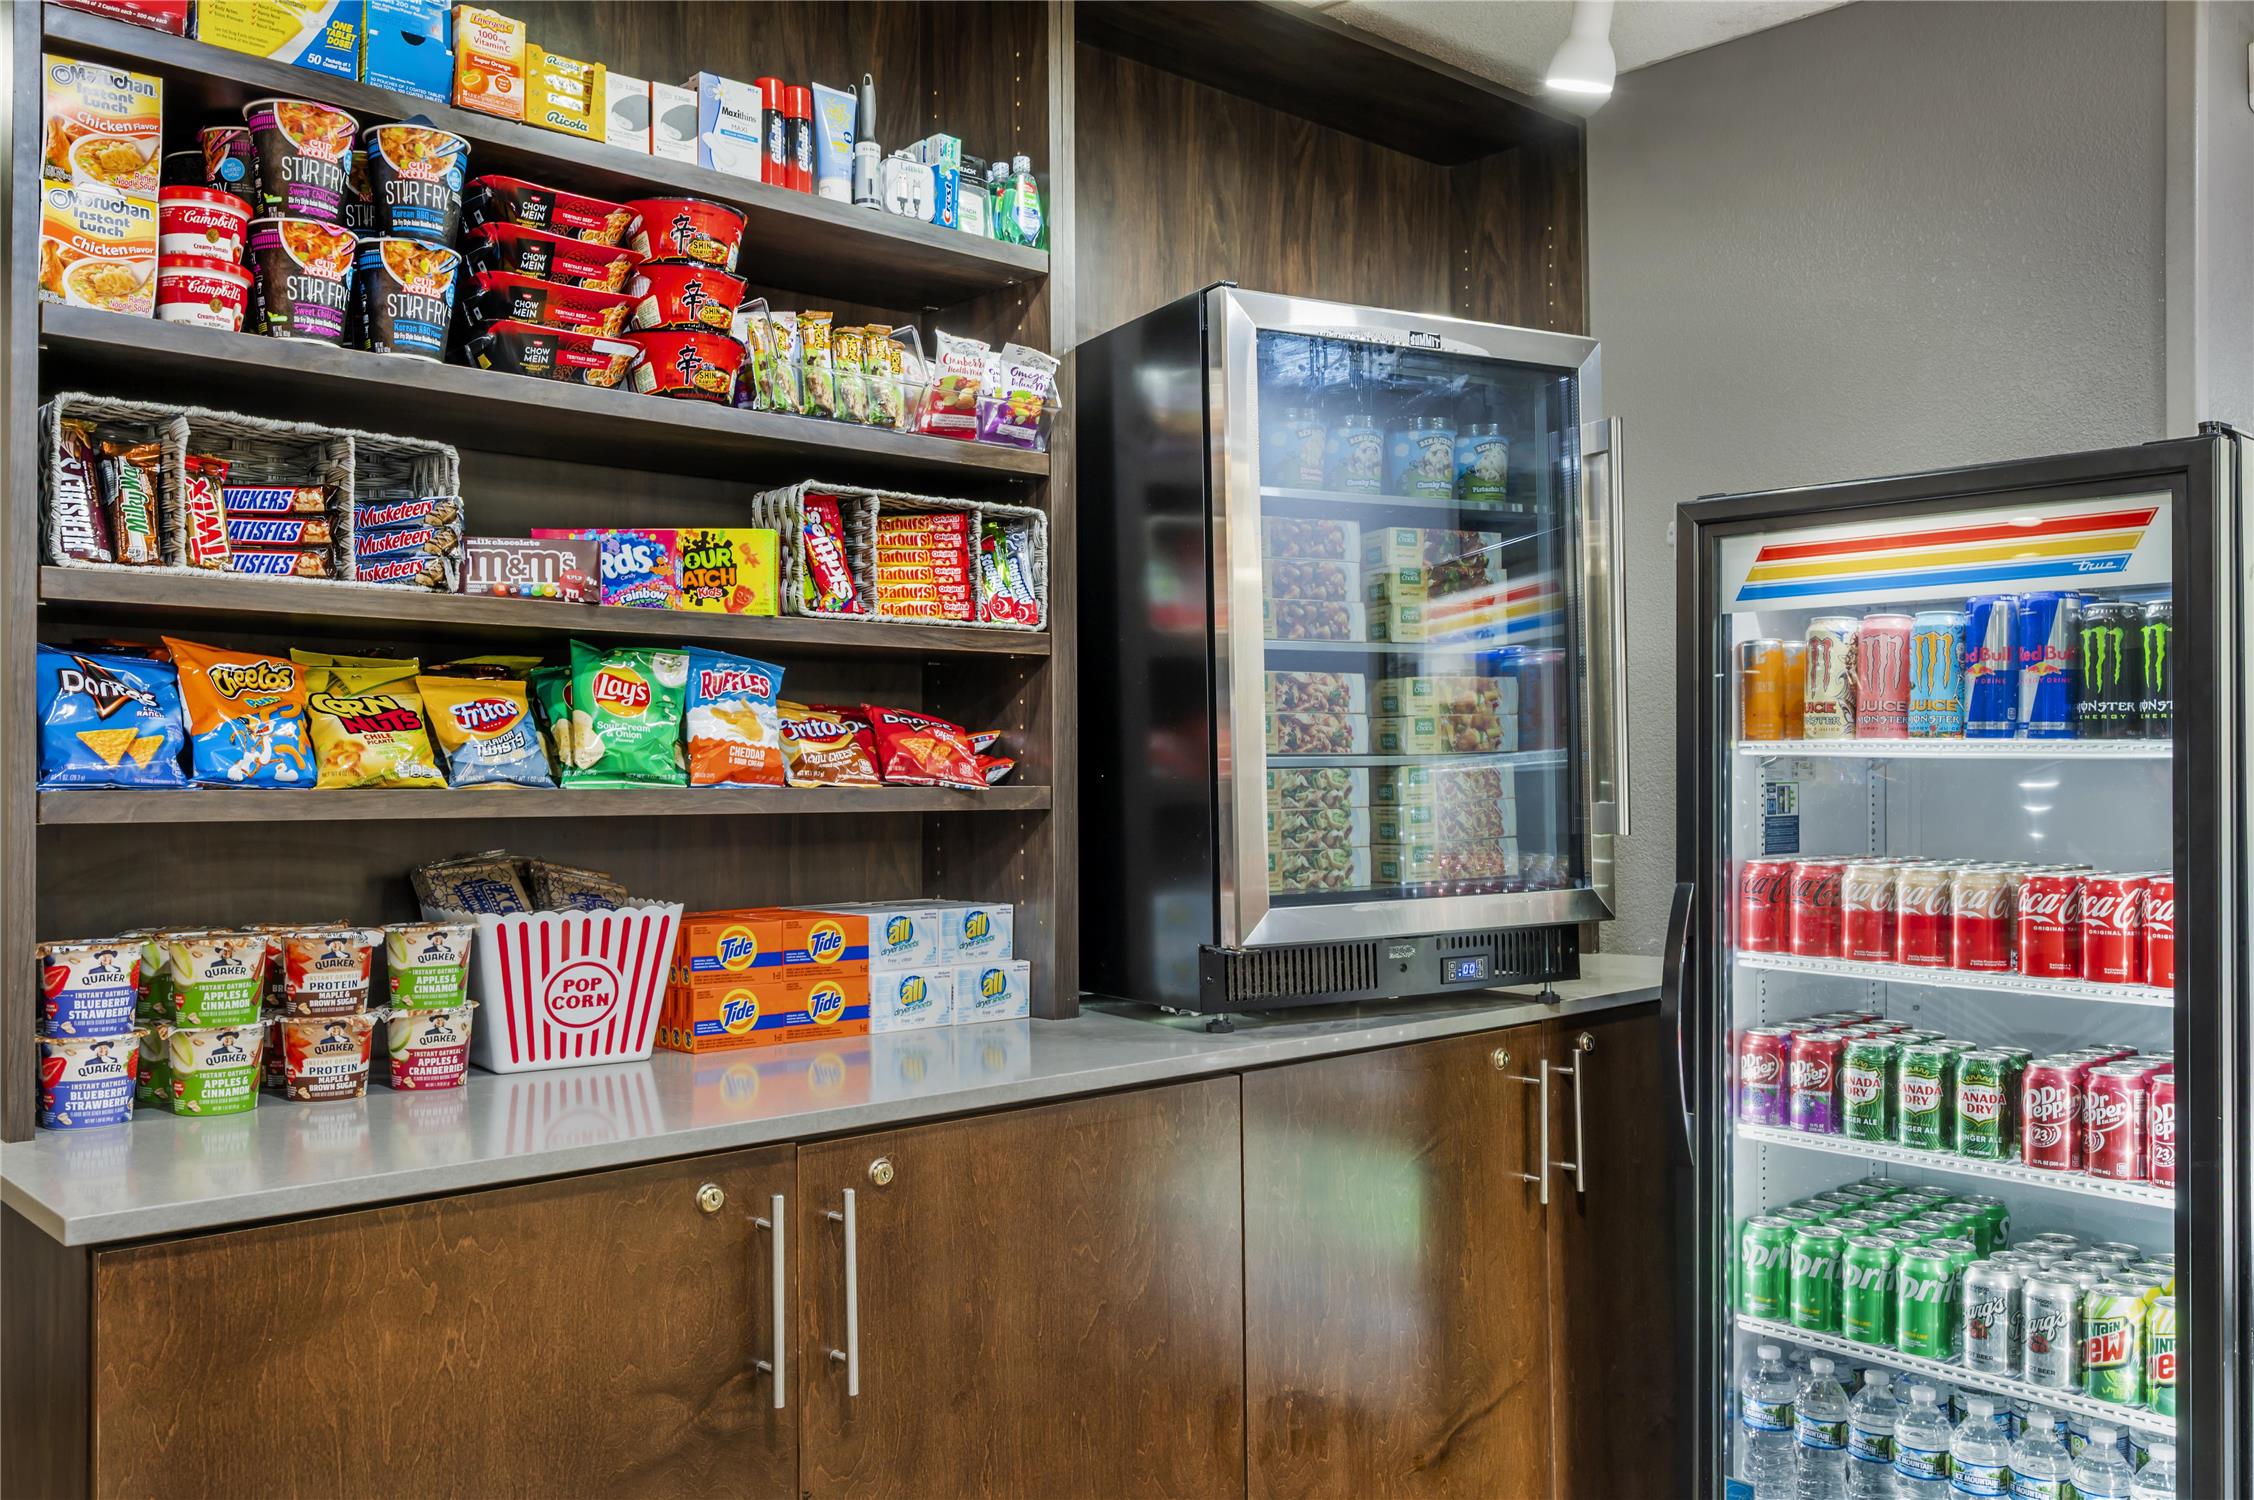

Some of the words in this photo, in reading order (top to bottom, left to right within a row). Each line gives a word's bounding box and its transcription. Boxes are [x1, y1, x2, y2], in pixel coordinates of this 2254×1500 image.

[332, 20, 354, 31] ONE
[326, 29, 357, 42] TABLET
[478, 30, 498, 41] 1000
[327, 38, 352, 50] DOSE!
[473, 36, 504, 51] Vitamin
[504, 45, 511, 53] C
[307, 53, 322, 65] 50
[76, 84, 134, 104] Instant
[83, 95, 128, 114] Lunch
[77, 111, 132, 133] Chicken
[133, 123, 158, 132] Flavor
[547, 111, 588, 132] Ricola
[309, 140, 332, 150] CUP
[299, 148, 339, 164] NOODLES
[409, 161, 431, 171] CUP
[135, 173, 158, 185] Ramen
[322, 165, 345, 194] FRY
[398, 168, 439, 183] NOODLES
[115, 176, 138, 189] Noodle
[139, 181, 156, 191] Soup
[424, 186, 450, 212] FRY
[943, 184, 953, 223] Crest
[523, 202, 547, 212] CHOW
[73, 206, 131, 228] Instant
[183, 210, 239, 232] Campbell's
[392, 210, 415, 219] Korean
[521, 211, 545, 221] MEIN
[79, 221, 124, 238] Lunch
[670, 214, 696, 254] 辛
[72, 235, 127, 256] Chicken
[693, 241, 712, 250] SHIN
[314, 258, 337, 268] CUP
[522, 252, 547, 262] CHOW
[520, 261, 545, 271] MEIN
[304, 266, 342, 282] NOODLES
[413, 277, 435, 286] CUP
[188, 280, 241, 301] Campbell's
[327, 284, 349, 310] FRY
[110, 300, 133, 310] Noodle
[133, 304, 150, 313] Soup
[128, 296, 151, 305] Ramen
[514, 299, 538, 310] CHOW
[682, 280, 707, 320] 辛
[427, 300, 448, 326] FRY
[513, 307, 537, 318] MEIN
[704, 307, 720, 315] SHIN
[1410, 332, 1441, 349] SUMMIT
[525, 346, 550, 357] CHOW
[523, 354, 549, 364] MEIN
[675, 345, 702, 385] 辛
[699, 371, 716, 379] SHIN
[60, 457, 98, 550] HERSHEY'S
[360, 500, 434, 528] Musketeers
[185, 477, 228, 566] TWIX
[358, 529, 433, 556] Musketeers
[467, 538, 492, 546] milk
[806, 511, 854, 600] Skittles
[467, 549, 576, 584] m&m's
[2073, 559, 2117, 571] true
[621, 573, 636, 581] Candy
[620, 587, 668, 604] rainbow
[697, 586, 723, 599] Kids
[877, 586, 936, 599] Starburst
[881, 603, 942, 616] Starburst
[1979, 645, 2011, 662] Bull
[2045, 645, 2075, 662] Bull
[211, 662, 294, 698] Cheetos
[701, 669, 770, 699] RUFFLES
[60, 669, 157, 707] Doritos
[597, 674, 648, 705] Lay's
[309, 692, 399, 718] CORN
[1859, 700, 1906, 712] JUICE
[1910, 699, 1957, 711] JUICE
[450, 699, 520, 729] Fritos
[340, 708, 422, 734] NUTS
[597, 720, 620, 732] Sour
[621, 721, 650, 732] Cream
[615, 729, 642, 739] Onion
[780, 718, 849, 742] Fritos
[364, 733, 393, 741] CHILE
[484, 731, 515, 747] FLAVOR
[729, 745, 765, 761] CHEDDAR
[889, 917, 912, 945] all
[966, 912, 988, 939] all
[720, 937, 753, 964] Tide
[811, 931, 842, 957] Tide
[959, 941, 976, 950] dryer
[881, 946, 898, 956] dryer
[417, 954, 455, 964] QUAKER
[205, 966, 247, 979] QUAKER
[82, 974, 125, 986] QUAKER
[199, 983, 225, 991] INSTANT
[226, 982, 252, 990] OATMEAL
[309, 980, 359, 991] PROTEIN
[416, 976, 450, 985] APPLES
[563, 977, 602, 993] POP
[982, 970, 1005, 997] all
[75, 991, 102, 999] INSTANT
[103, 989, 130, 997] OATMEAL
[203, 989, 240, 1001] APPLES
[414, 984, 458, 994] CINNAMON
[901, 976, 925, 1005] all
[74, 997, 130, 1009] BLUEBERRY
[201, 999, 250, 1012] CINNAMON
[336, 998, 357, 1006] SUGAR
[551, 992, 610, 1011] CORN
[811, 992, 842, 1018] Tide
[975, 999, 992, 1008] dryer
[69, 1007, 131, 1020] STRAWBERRY
[723, 1000, 755, 1027] Tide
[894, 1006, 911, 1016] dryer
[206, 1053, 247, 1066] QUAKER
[417, 1057, 452, 1066] APPLES
[78, 1063, 122, 1077] QUAKER
[309, 1064, 358, 1075] PROTEIN
[409, 1065, 464, 1076] CRANBERRIES
[71, 1082, 98, 1090] INSTANT
[204, 1078, 240, 1089] APPLES
[336, 1082, 357, 1090] SUGAR
[70, 1087, 127, 1101] BLUEBERRY
[201, 1087, 249, 1099] CINNAMON
[65, 1097, 129, 1111] STRAWBERRY
[1904, 1095, 1929, 1106] DRY
[1966, 1103, 1994, 1115] DRY
[1865, 1118, 1878, 1126] ALE
[1923, 1126, 1939, 1134] ALE
[2033, 1128, 2048, 1140] 23
[1989, 1135, 2003, 1144] ALE
[2155, 1146, 2170, 1158] 23
[1977, 1353, 1994, 1362] BEER
[2039, 1368, 2056, 1376] BEER
[1902, 1458, 1936, 1471] MOUNTAIN
[1965, 1474, 1999, 1487] MOUNTAIN
